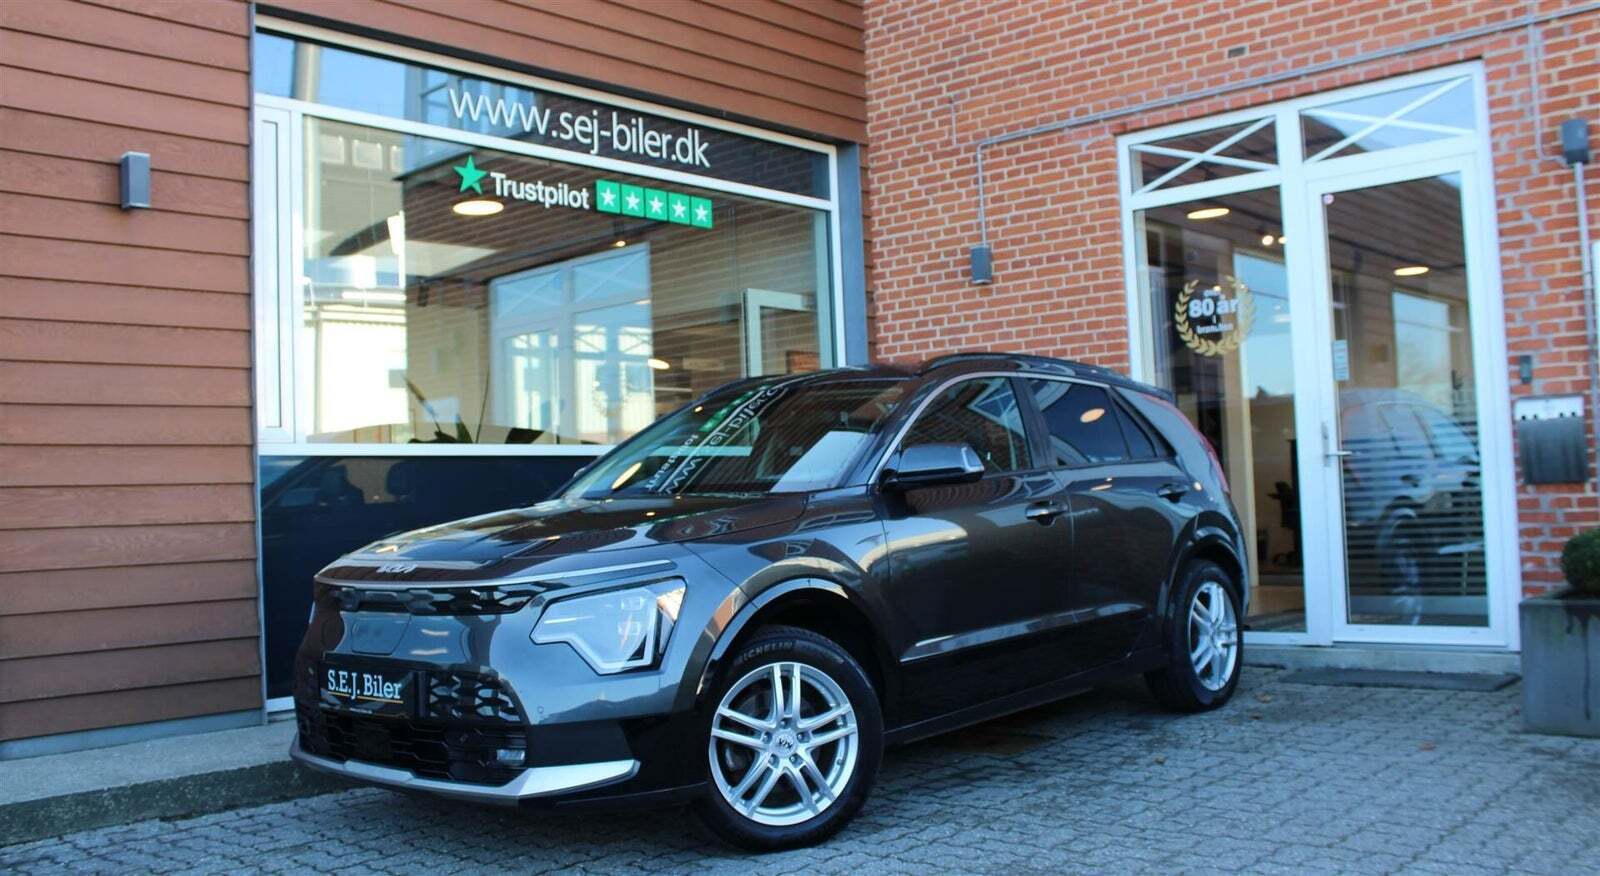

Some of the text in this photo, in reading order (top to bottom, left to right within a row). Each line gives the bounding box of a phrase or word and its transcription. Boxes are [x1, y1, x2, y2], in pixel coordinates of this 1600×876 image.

[450, 88, 711, 168] www.sej-biler.dk
[490, 172, 590, 211] Trustpilot
[1188, 299, 1215, 317] 80
[327, 669, 403, 700] S.E.J. Biler
